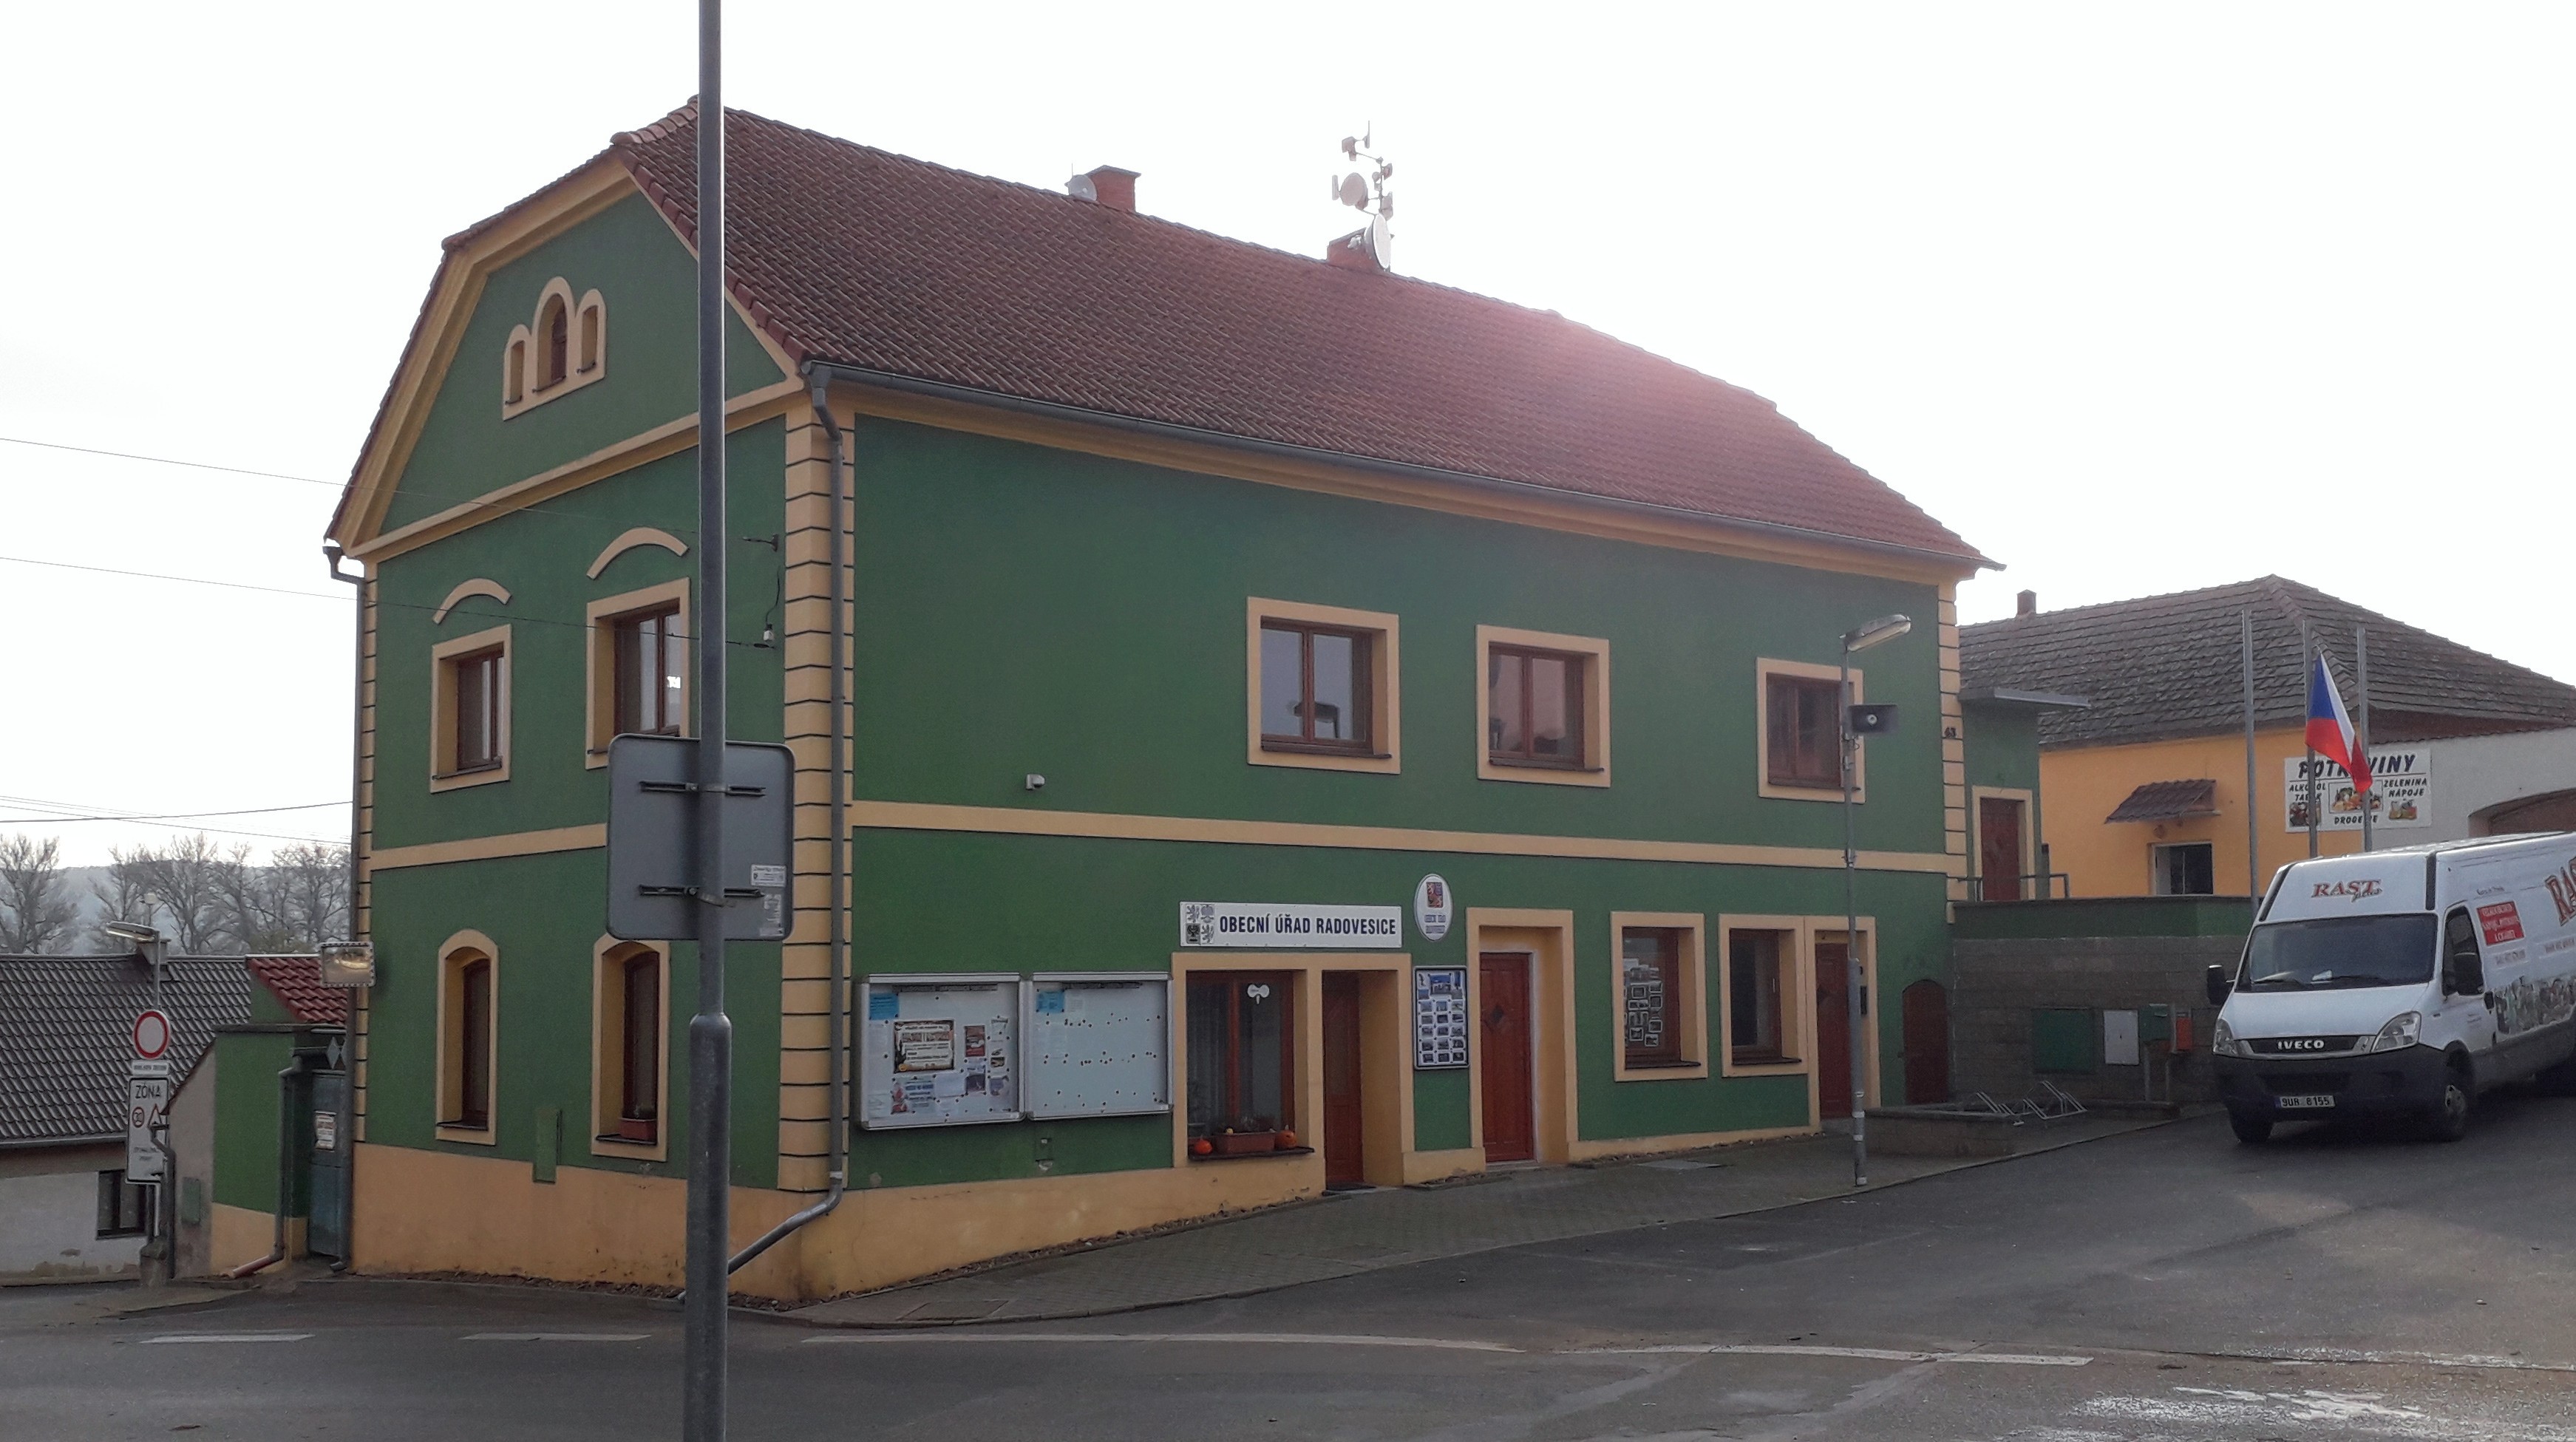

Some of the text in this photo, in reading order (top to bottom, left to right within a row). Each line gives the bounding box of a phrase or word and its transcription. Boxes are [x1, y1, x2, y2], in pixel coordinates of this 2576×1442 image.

[2298, 754, 2416, 779] POTRVINY
[2289, 783, 2326, 792] ALKOOL
[2384, 778, 2427, 788] ZELENINA
[2311, 879, 2382, 898] RAST
[1219, 913, 1396, 935] OBECNÍ ÚŘAD RADOVESICE
[2277, 1040, 2325, 1050] IVECO
[135, 1082, 162, 1099] ZÓNA
